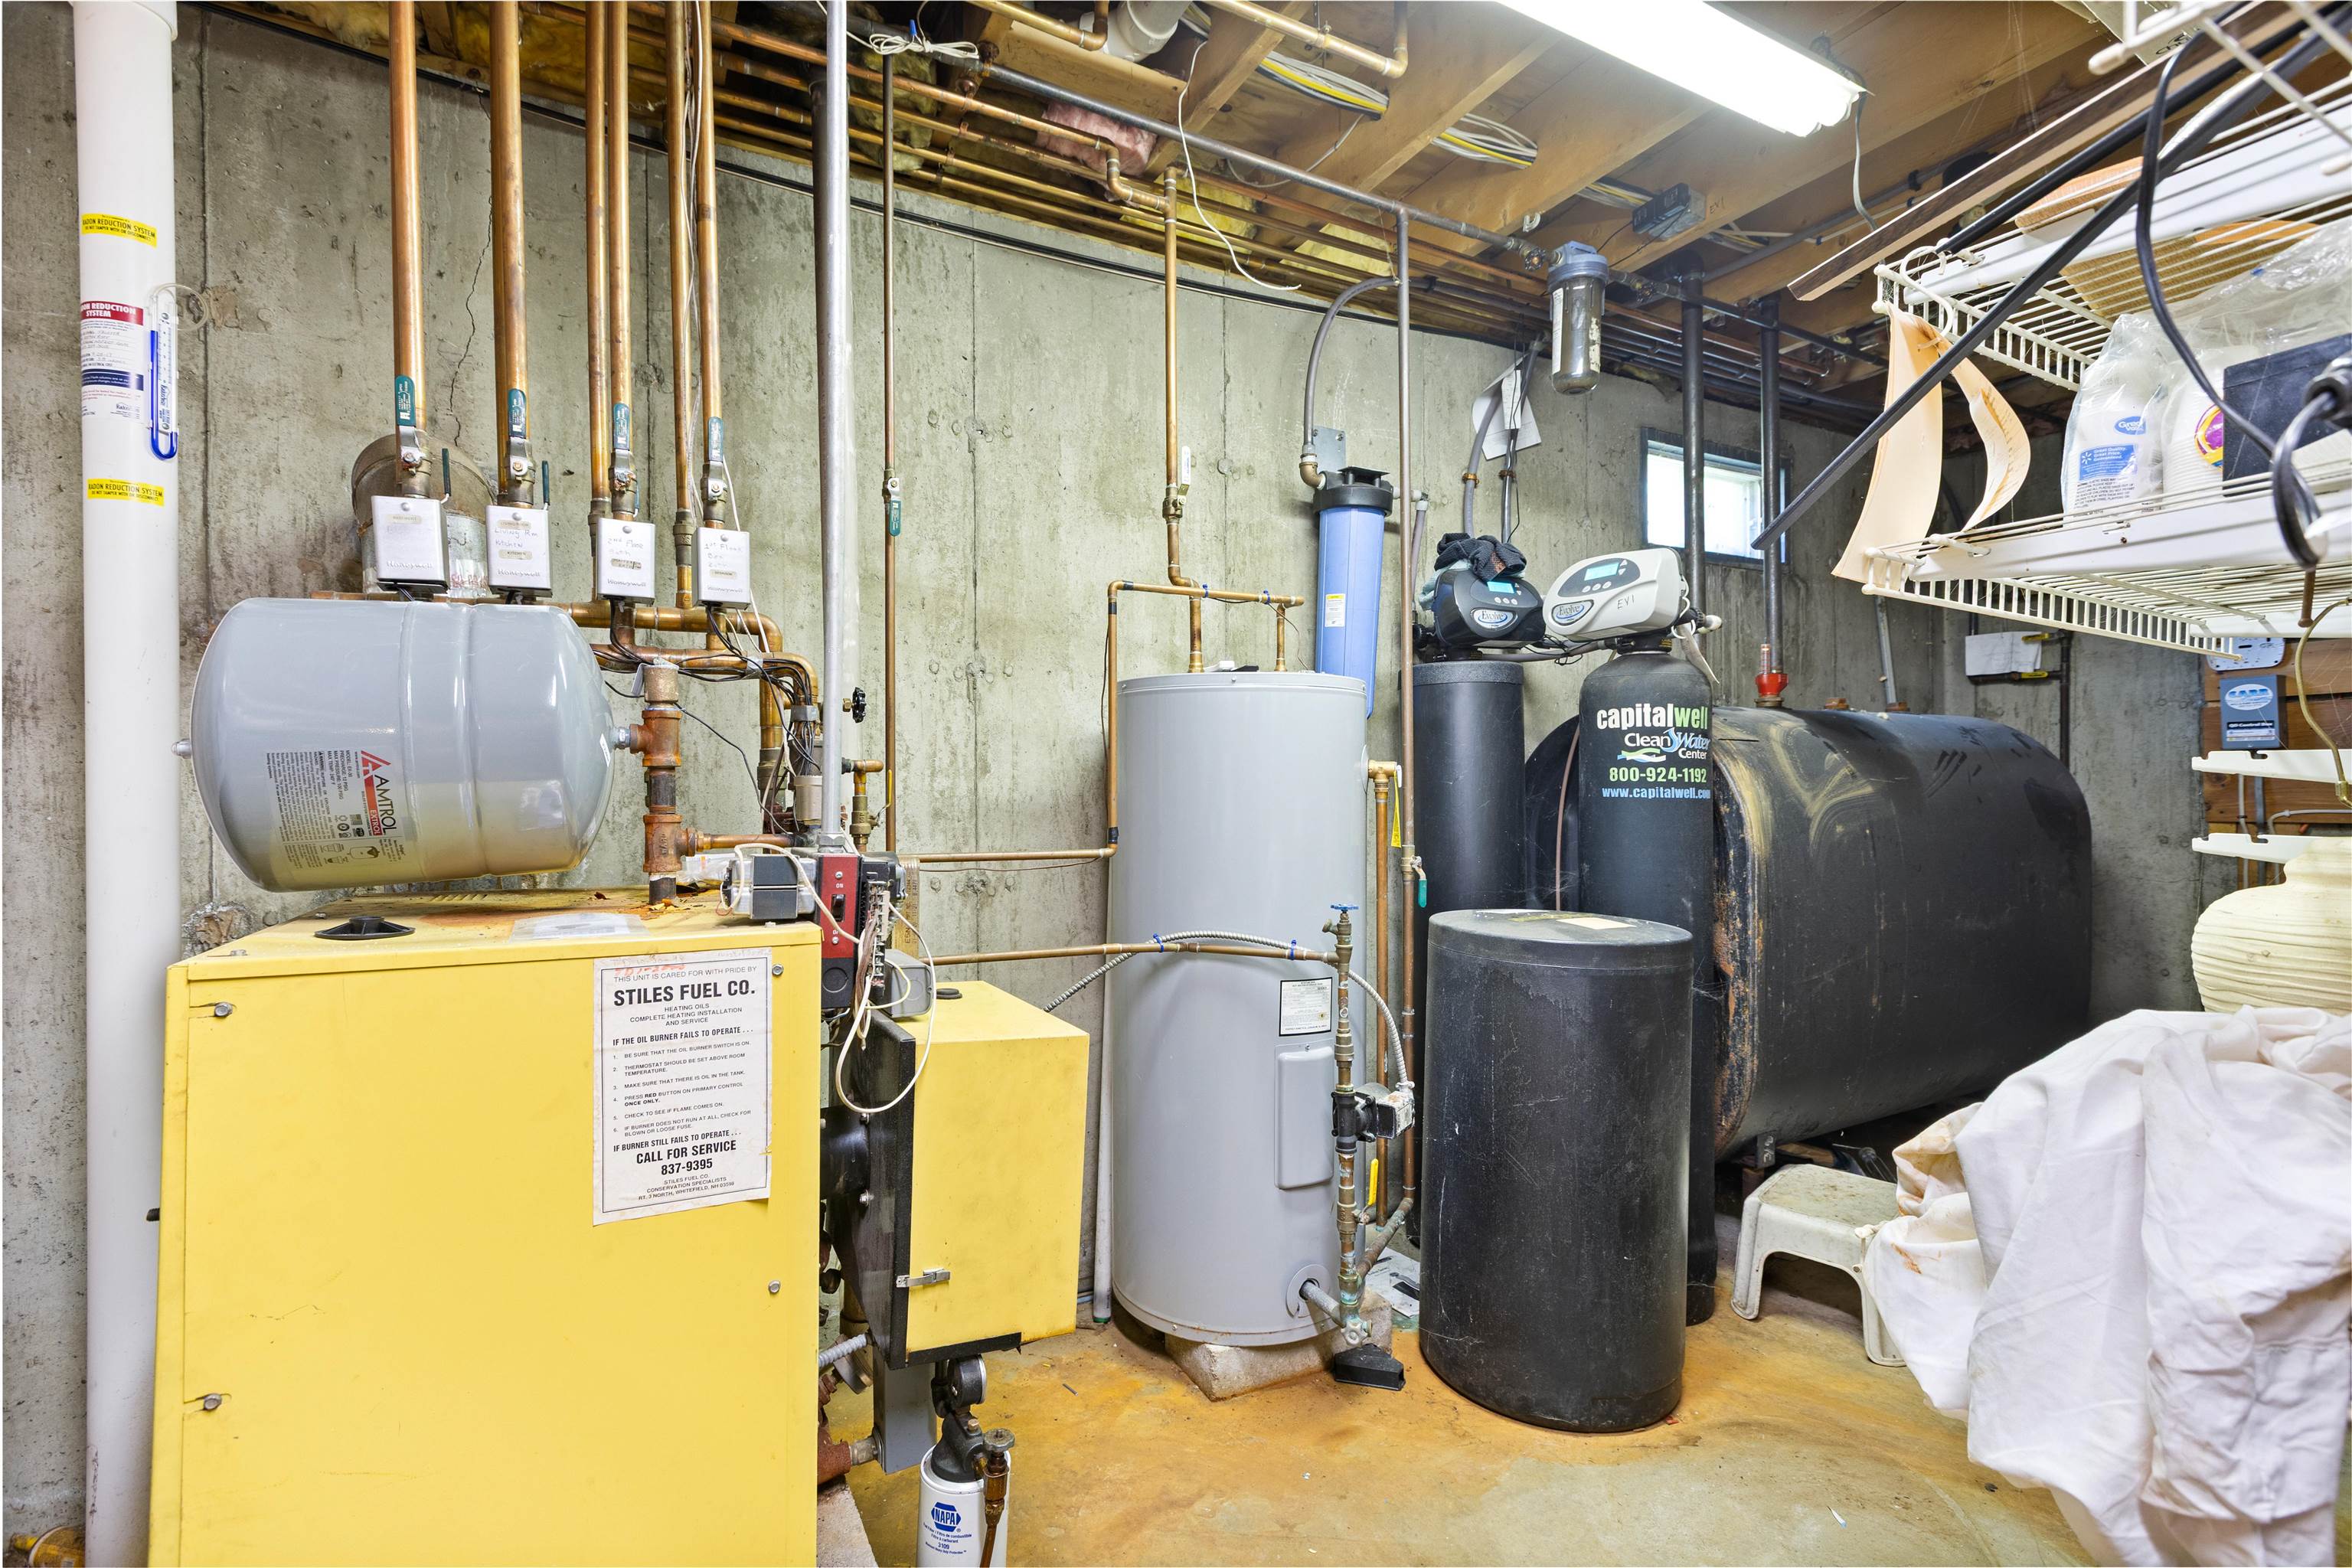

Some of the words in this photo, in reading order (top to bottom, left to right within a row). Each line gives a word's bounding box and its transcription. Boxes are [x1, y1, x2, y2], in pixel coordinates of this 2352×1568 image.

[98, 219, 131, 230] REDUCTION
[134, 226, 155, 237] SYSTEM
[92, 303, 136, 315] REDUCTION
[105, 484, 139, 493] REDUCTION
[142, 488, 162, 497] SYSTEM
[498, 569, 541, 577] Honeywell
[1481, 610, 1504, 620] Evolve
[1559, 605, 1580, 616] Evolve
[1597, 703, 1707, 730] capitalwell
[1625, 733, 1671, 747] Clean
[1676, 732, 1710, 750] Water
[1678, 748, 1707, 760] Center
[1609, 767, 1707, 782] 800-924-1192
[374, 775, 397, 835] AMTROL
[371, 810, 381, 835] EXTROL
[613, 975, 631, 983] THIS
[660, 971, 686, 979] CARED
[613, 985, 673, 1006] STILES
[680, 982, 722, 1000] FUEL
[727, 979, 755, 996] CO.
[629, 1014, 665, 1022] COMPLETE
[697, 1007, 742, 1016] INSTALLATION
[621, 1037, 635, 1045] THE
[650, 1033, 678, 1042] BURNER
[680, 1031, 699, 1039] FAILS
[711, 1026, 740, 1036] OPERATE
[624, 1062, 662, 1070] THERMOSTAT
[622, 1141, 648, 1151] BURNER
[651, 1138, 668, 1147] STILL
[671, 1135, 688, 1144] FAILS
[701, 1129, 730, 1139] OPERATE
[636, 1150, 663, 1164] CALL
[667, 1147, 688, 1159] FOR
[691, 1139, 736, 1156] SERVICE
[661, 1158, 712, 1175] 837-9395
[646, 1182, 691, 1193] CONSERVATION
[691, 1176, 727, 1186] SPECIALISTS
[664, 1177, 683, 1185] STILES
[675, 1185, 709, 1194] WHITEFIELD,
[936, 1508, 956, 1525] NAPA
